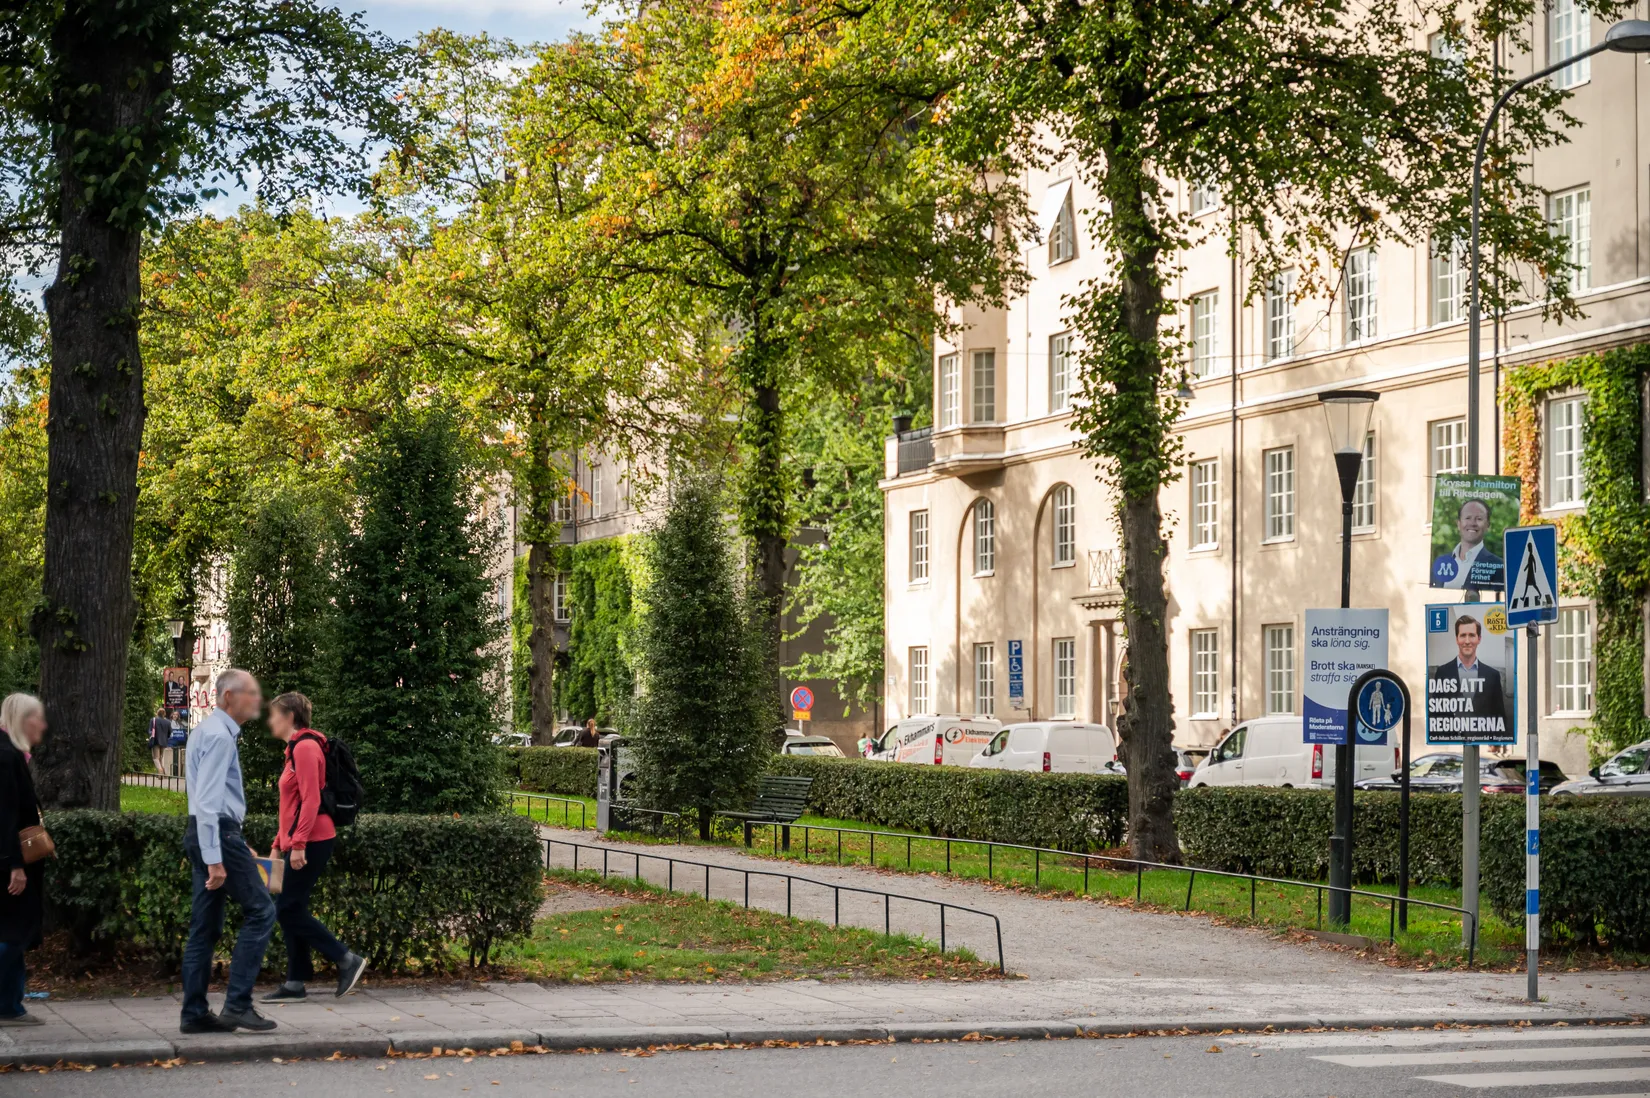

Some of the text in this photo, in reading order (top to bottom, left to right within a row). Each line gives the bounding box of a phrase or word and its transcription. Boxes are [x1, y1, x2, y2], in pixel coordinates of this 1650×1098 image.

[1440, 478, 1517, 490] Kryssa Hamilton
[1439, 488, 1503, 499] till Riksdagen
[1471, 567, 1497, 575] Försvar
[1311, 626, 1380, 639] Ansträngning
[1012, 642, 1020, 655] P
[1311, 637, 1371, 650] ska löna sig.
[1310, 660, 1335, 671] Brott
[1337, 660, 1356, 671] ska
[1310, 672, 1341, 684] straffa
[1428, 677, 1486, 693] DAGS ATT
[1428, 697, 1474, 713] SKROTA
[1325, 717, 1333, 725] på
[1429, 716, 1506, 732] REGIONERNA
